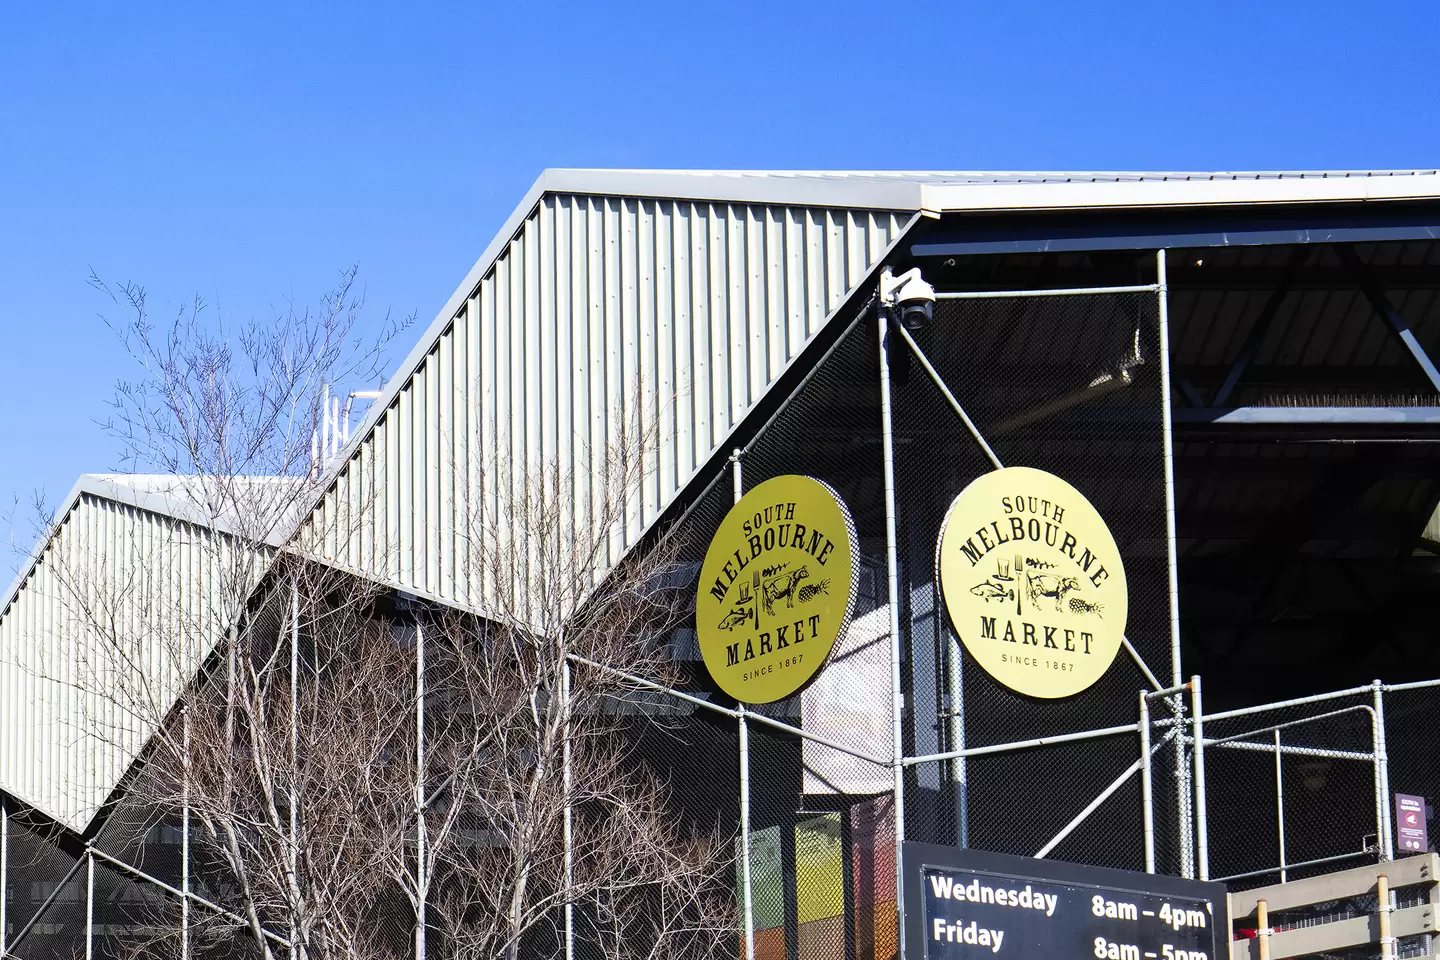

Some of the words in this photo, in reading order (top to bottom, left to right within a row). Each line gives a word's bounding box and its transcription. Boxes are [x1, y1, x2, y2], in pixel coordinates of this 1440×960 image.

[742, 502, 796, 538] SOUTH
[1002, 495, 1065, 524] SOUTH
[710, 523, 835, 604] MELBOURNE
[959, 517, 1109, 589] MELBOURNE
[725, 614, 820, 667] MARKET
[980, 615, 1093, 655] MARKET
[743, 664, 773, 681] SINCE
[779, 654, 804, 669] 1867
[1001, 654, 1038, 667] SINCE
[1045, 660, 1074, 672] 1867
[930, 874, 1058, 917] Wednesday
[1091, 895, 1138, 921] 8am
[1158, 903, 1206, 931] 4pm
[933, 918, 1005, 953] Friday
